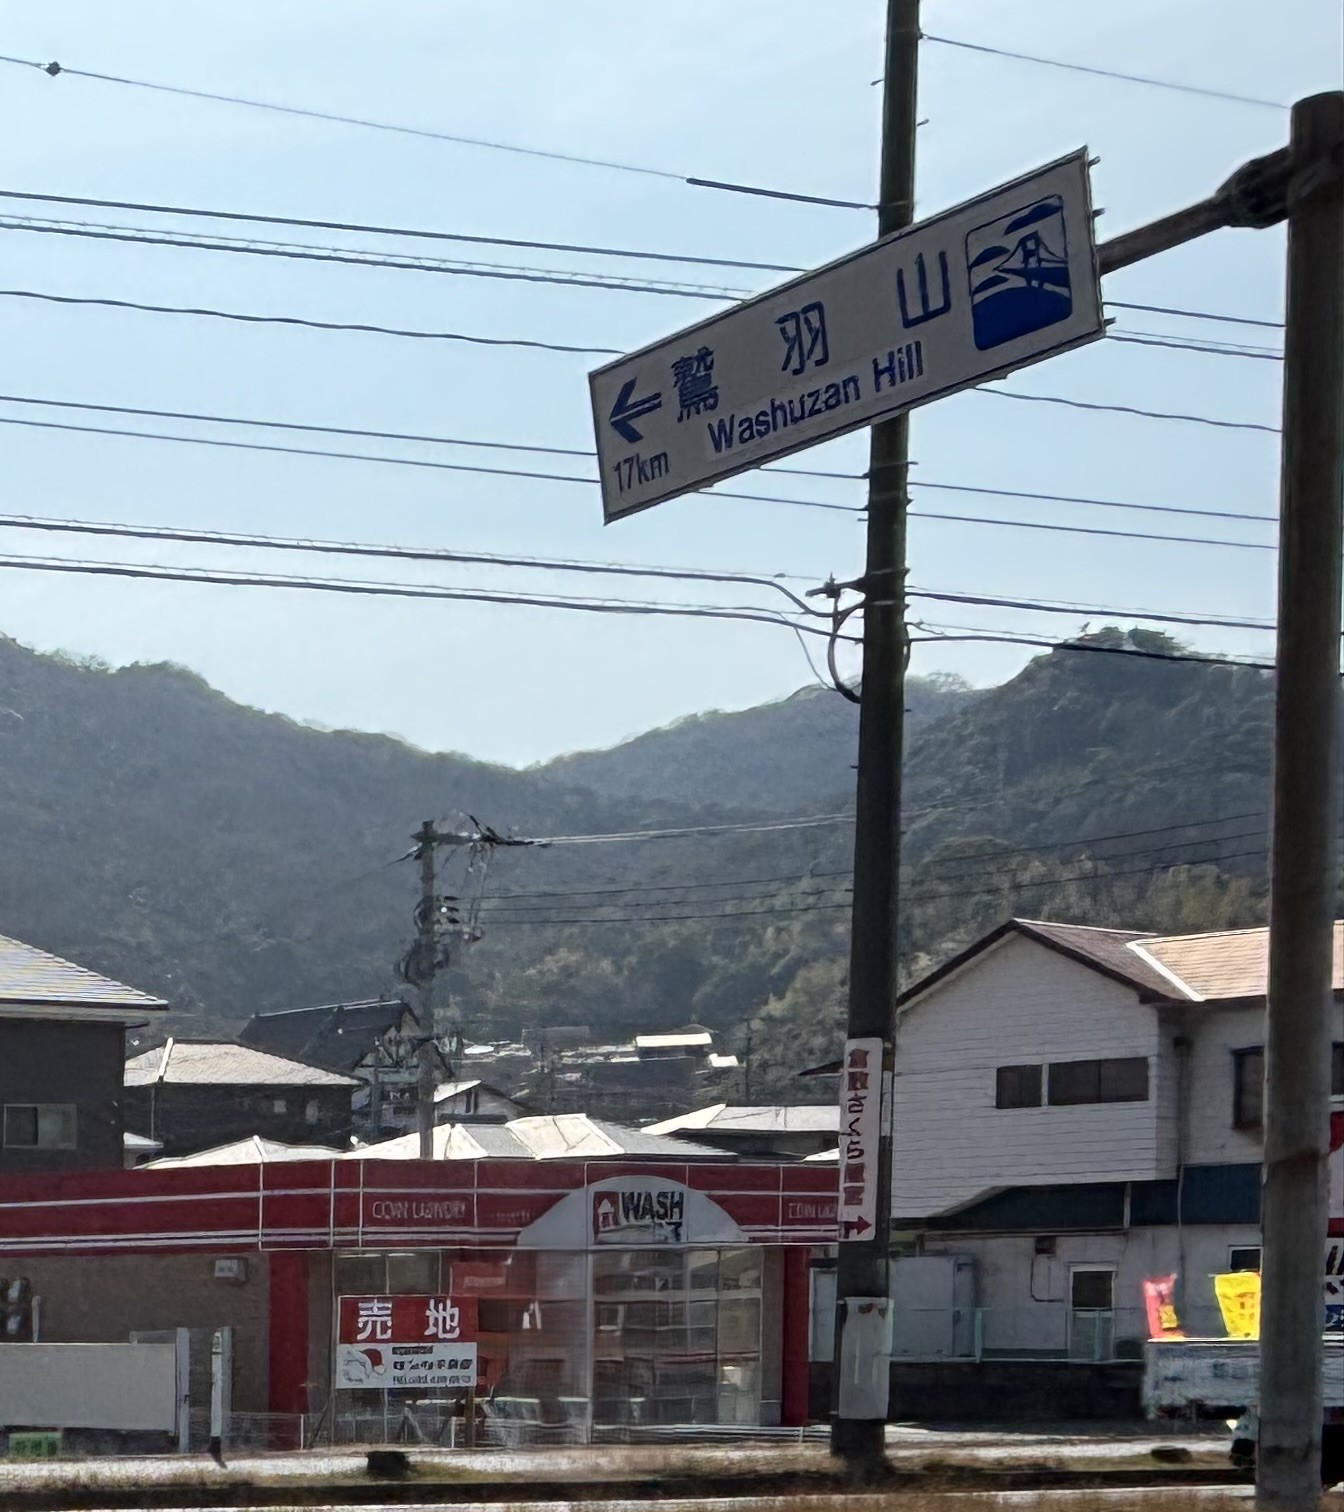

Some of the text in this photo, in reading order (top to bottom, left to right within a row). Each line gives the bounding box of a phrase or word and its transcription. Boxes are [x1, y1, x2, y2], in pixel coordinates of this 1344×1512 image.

[671, 250, 952, 423] 鷲羽山
[708, 340, 924, 453] Washuzan Hill
[614, 451, 670, 492] 17km
[621, 1191, 684, 1222] WASH
[356, 1298, 460, 1340] 売地
